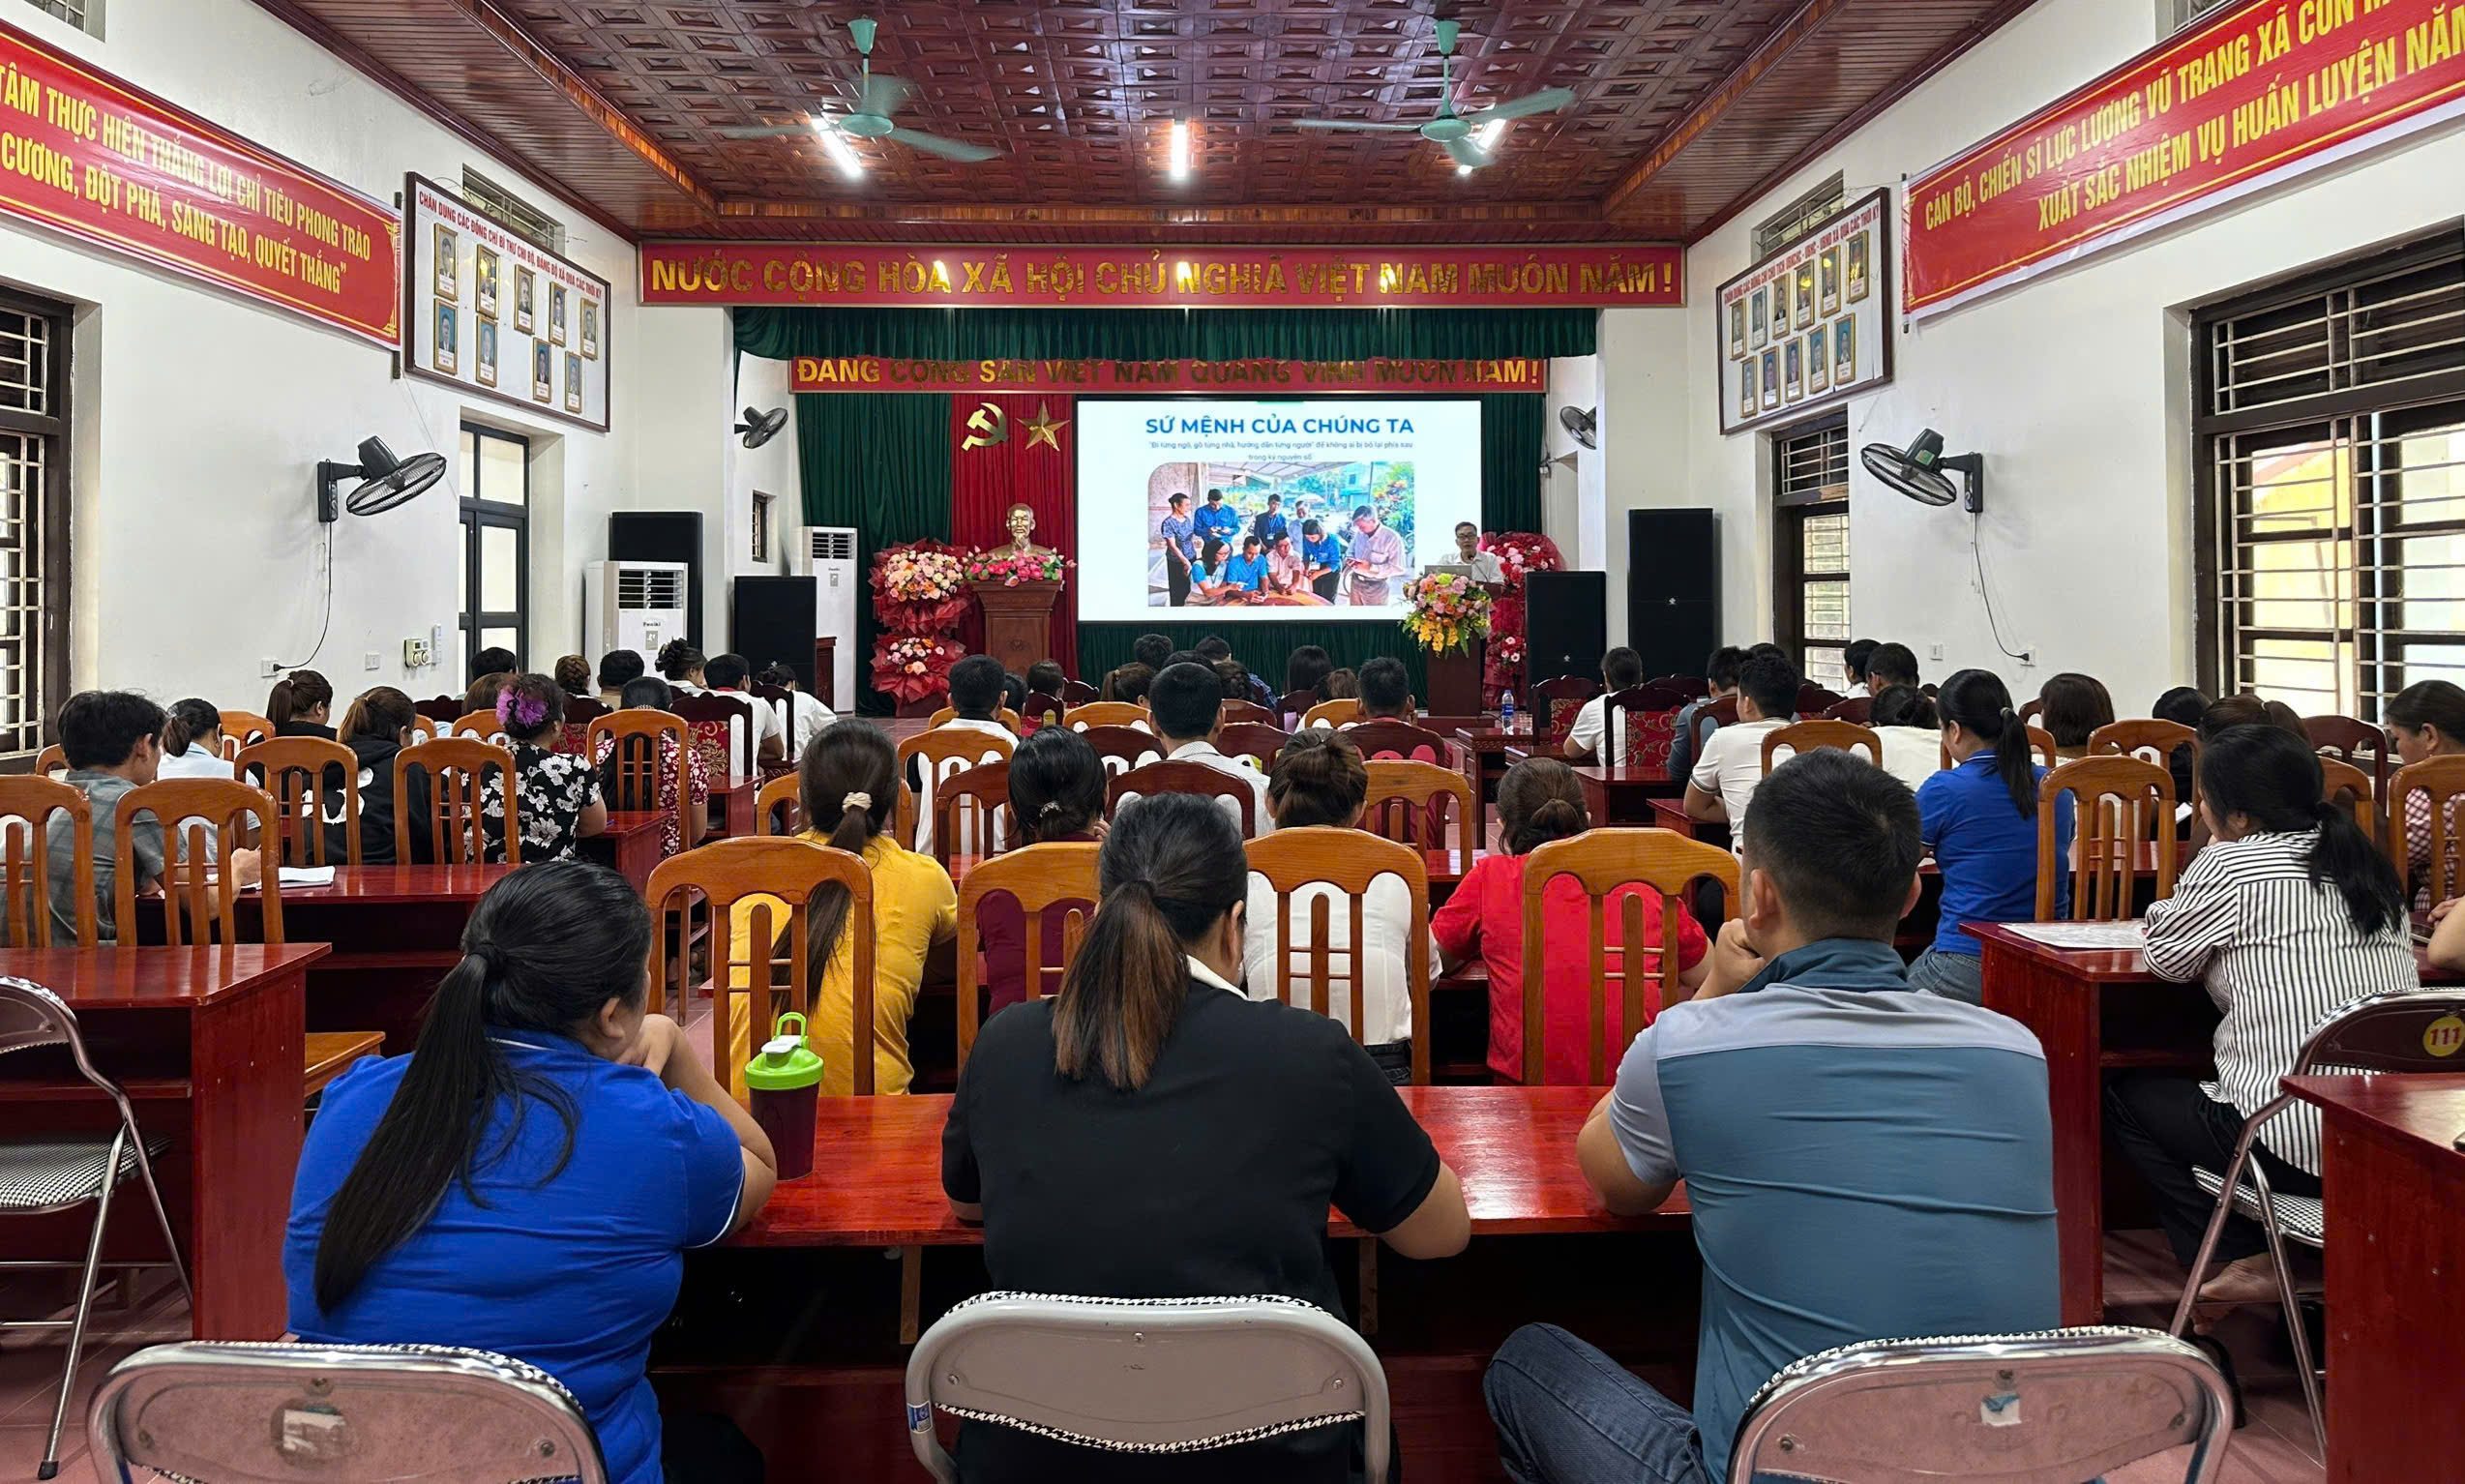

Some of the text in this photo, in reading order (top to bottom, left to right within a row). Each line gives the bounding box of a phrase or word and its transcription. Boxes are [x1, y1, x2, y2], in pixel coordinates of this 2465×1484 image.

[1925, 190, 1951, 230] CÁN
[1954, 176, 1975, 217] BỘ,
[1979, 148, 2022, 202] CHIẾN
[2026, 136, 2041, 179] SĨ
[2046, 124, 2077, 171] LỰC
[2081, 91, 2141, 152] LƯỢNG
[2145, 67, 2172, 120] VŨ
[2177, 34, 2250, 104] TRANG
[2257, 4, 2291, 67] XÃ
[2038, 173, 2079, 231] XUẤT
[2085, 156, 2121, 211] SẮC
[2125, 131, 2190, 193] NHIỆM
[2197, 114, 2225, 165] VỤ
[2233, 73, 2300, 148] HUẤN
[2307, 37, 2396, 116] LUYỆN
[46, 86, 97, 143] THỰC
[103, 113, 145, 163] HIỆN
[150, 133, 203, 188] THẮNG
[209, 162, 232, 203] LỢI
[237, 173, 261, 213] CHỈ
[263, 186, 294, 227] TIÊU
[296, 202, 339, 248] PHONG
[342, 223, 371, 261] TRÀO
[1, 132, 79, 200] CƯƠNG,
[85, 163, 121, 214] ĐỘT
[127, 181, 166, 232] PHÁ,
[172, 198, 215, 247] SÁNG
[220, 221, 251, 263] TẠO,
[255, 234, 297, 277] QUYẾT
[419, 191, 436, 213] CHÂN
[438, 202, 456, 223] DUNG
[457, 212, 469, 230] CÁC
[470, 220, 487, 240] ĐỒNG
[489, 229, 498, 246] CHÍ
[651, 249, 753, 291] NƯỚC
[763, 250, 866, 301] CỘNG
[877, 251, 952, 293] HÒA
[962, 252, 1014, 294] XÃ
[1026, 254, 1084, 301] HỘI
[1095, 249, 1166, 294] CHỦ
[1175, 253, 1287, 294] NGHĨA
[1295, 254, 1370, 302] VIỆT
[1380, 262, 1458, 294] NAM
[1468, 253, 1569, 294] MUÔN
[1114, 360, 1178, 383] NAM
[1191, 360, 1291, 383] QUANG
[1301, 360, 1365, 383] VINH
[1145, 413, 1414, 437] SỨ MỆNH CỦA CHÚNG TA
[2429, 1026, 2462, 1046] 111
